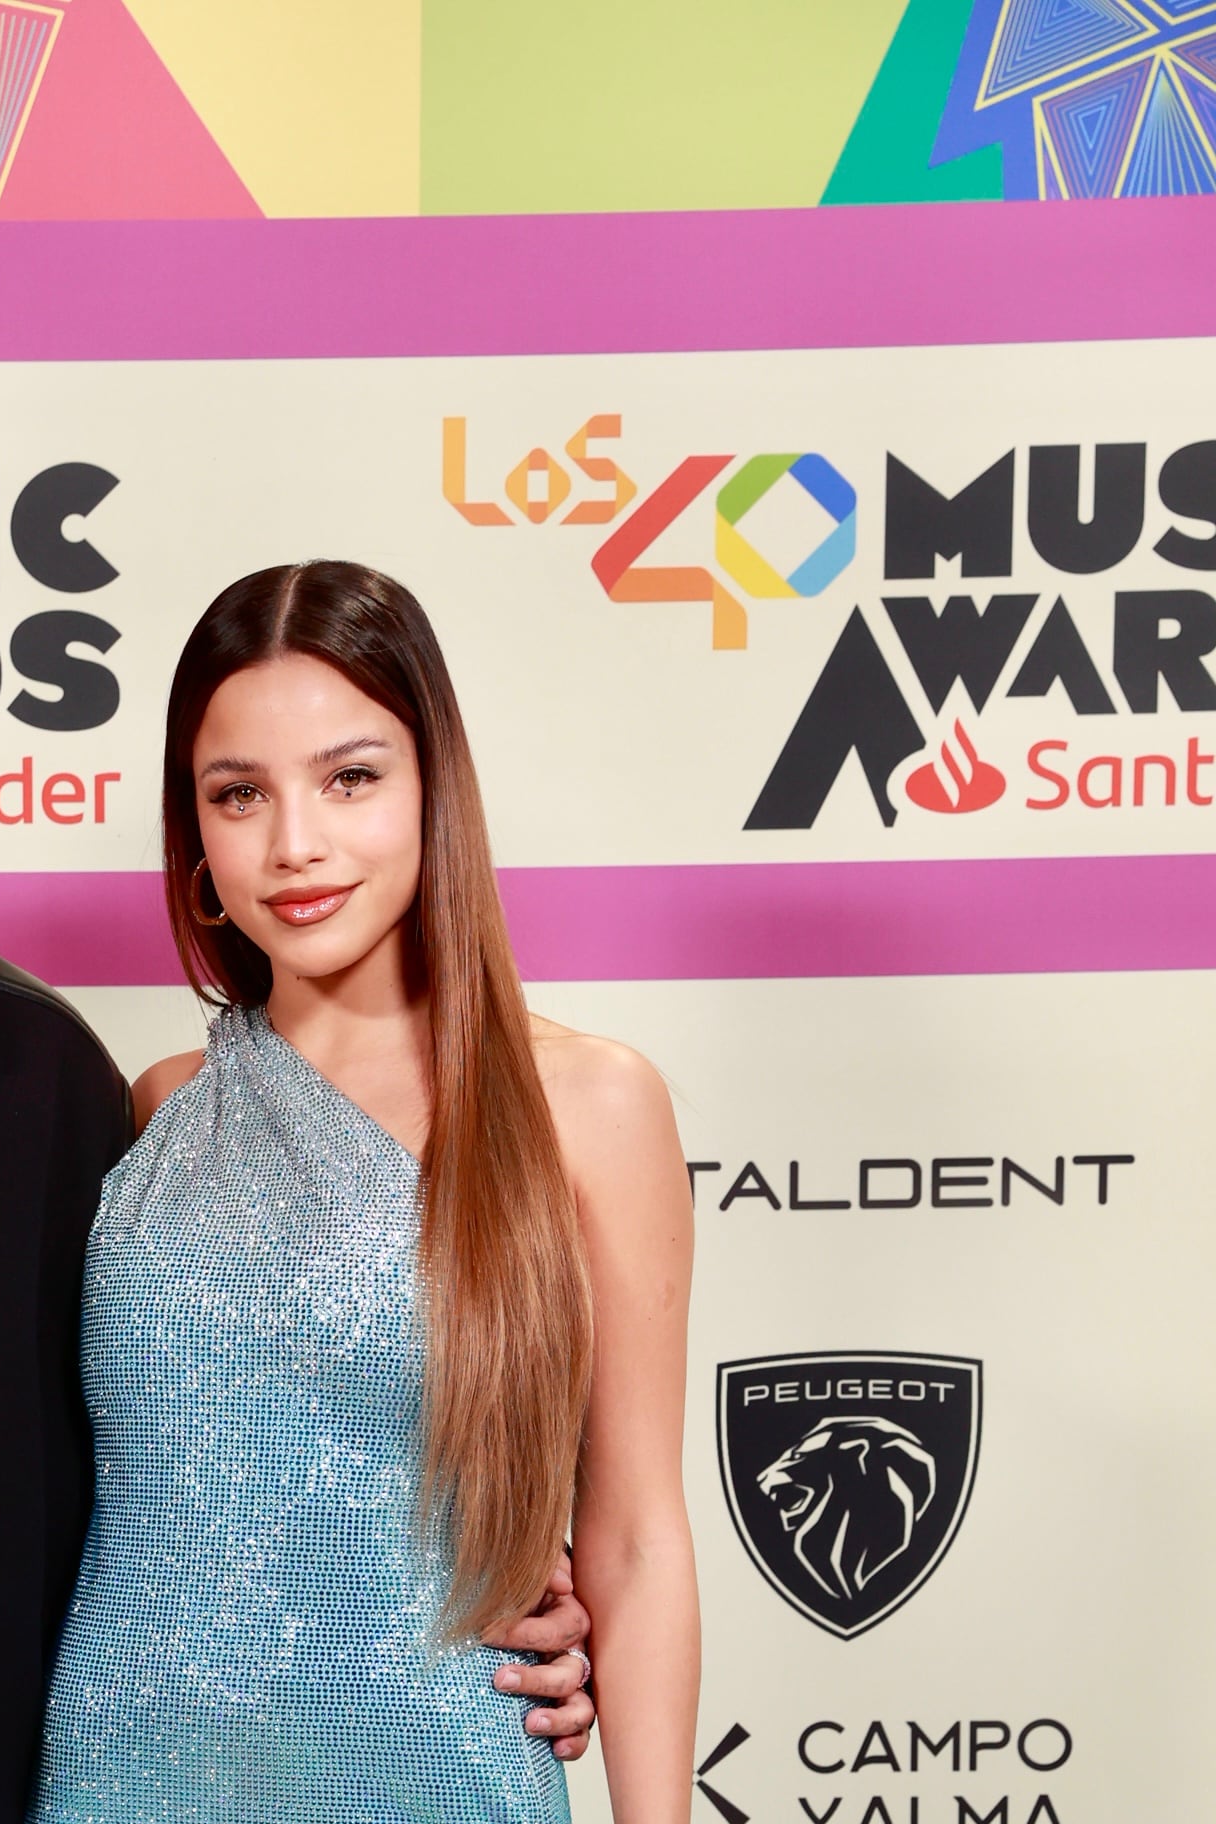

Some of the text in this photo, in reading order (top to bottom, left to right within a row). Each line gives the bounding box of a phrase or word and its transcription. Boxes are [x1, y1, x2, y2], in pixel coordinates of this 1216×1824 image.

[591, 453, 857, 651] 40
[744, 1379, 956, 1407] PEUGEOT
[797, 1718, 1074, 1774] CAMPO
